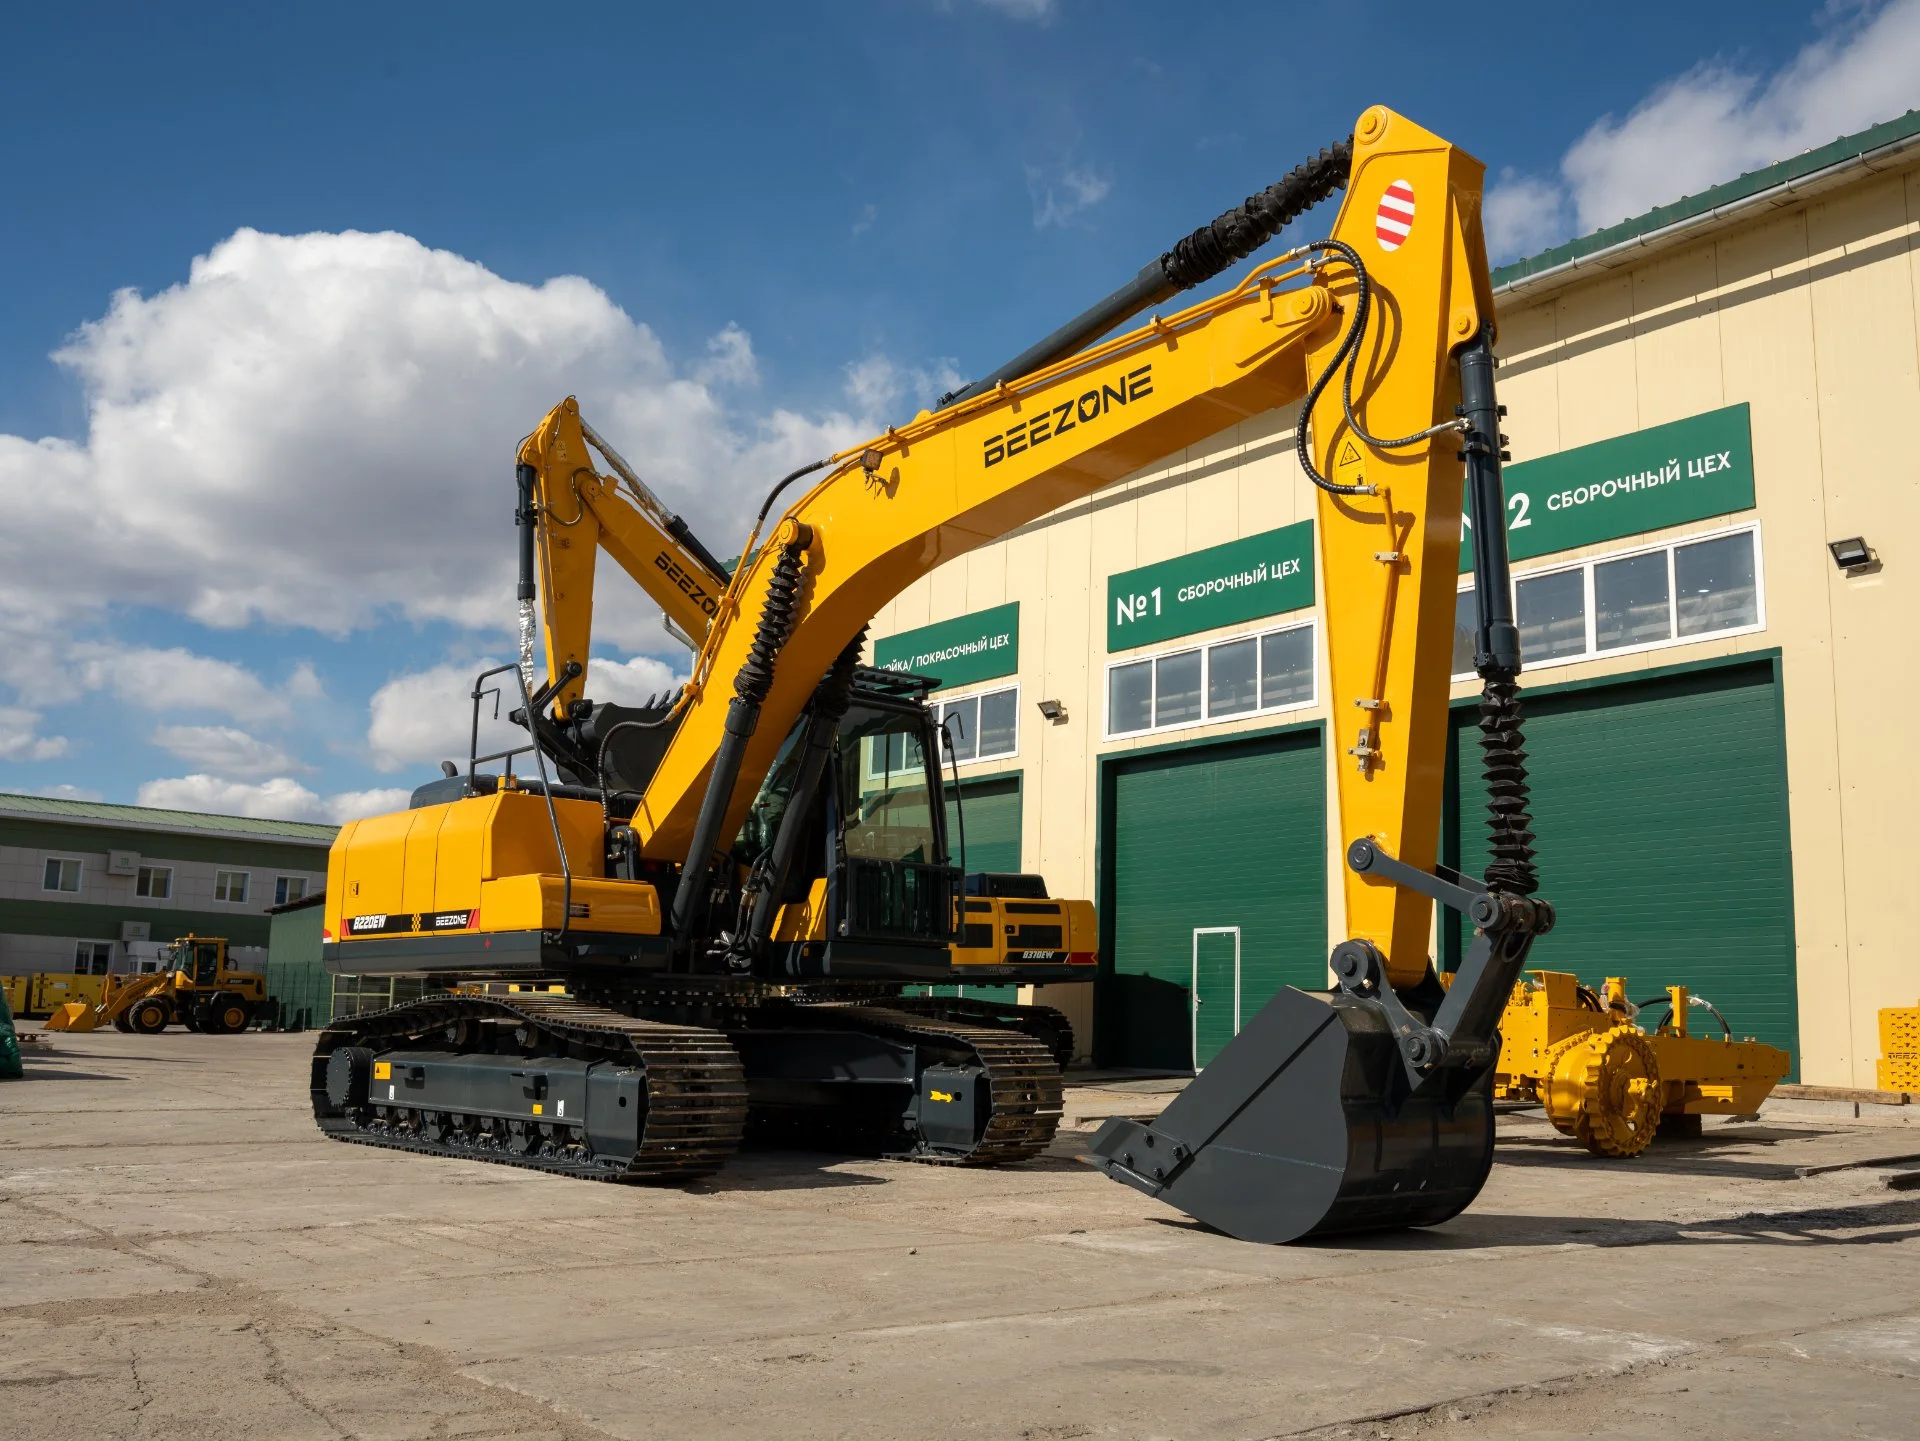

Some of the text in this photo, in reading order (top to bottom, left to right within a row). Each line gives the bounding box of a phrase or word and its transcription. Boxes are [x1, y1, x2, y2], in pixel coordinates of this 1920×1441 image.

[983, 363, 1154, 469] BEEZONE
[1546, 458, 1681, 511] СБОРОЧНЫЙ
[1688, 451, 1732, 479] ЦЕХ
[1177, 563, 1267, 602] СБОРОЧНЫЙ
[1271, 558, 1301, 580] ЦЕХ
[916, 636, 987, 668] ПОКРАСОЧНЫЙ
[989, 633, 1009, 650] ЦЕХ
[435, 914, 468, 927] BEEZONE
